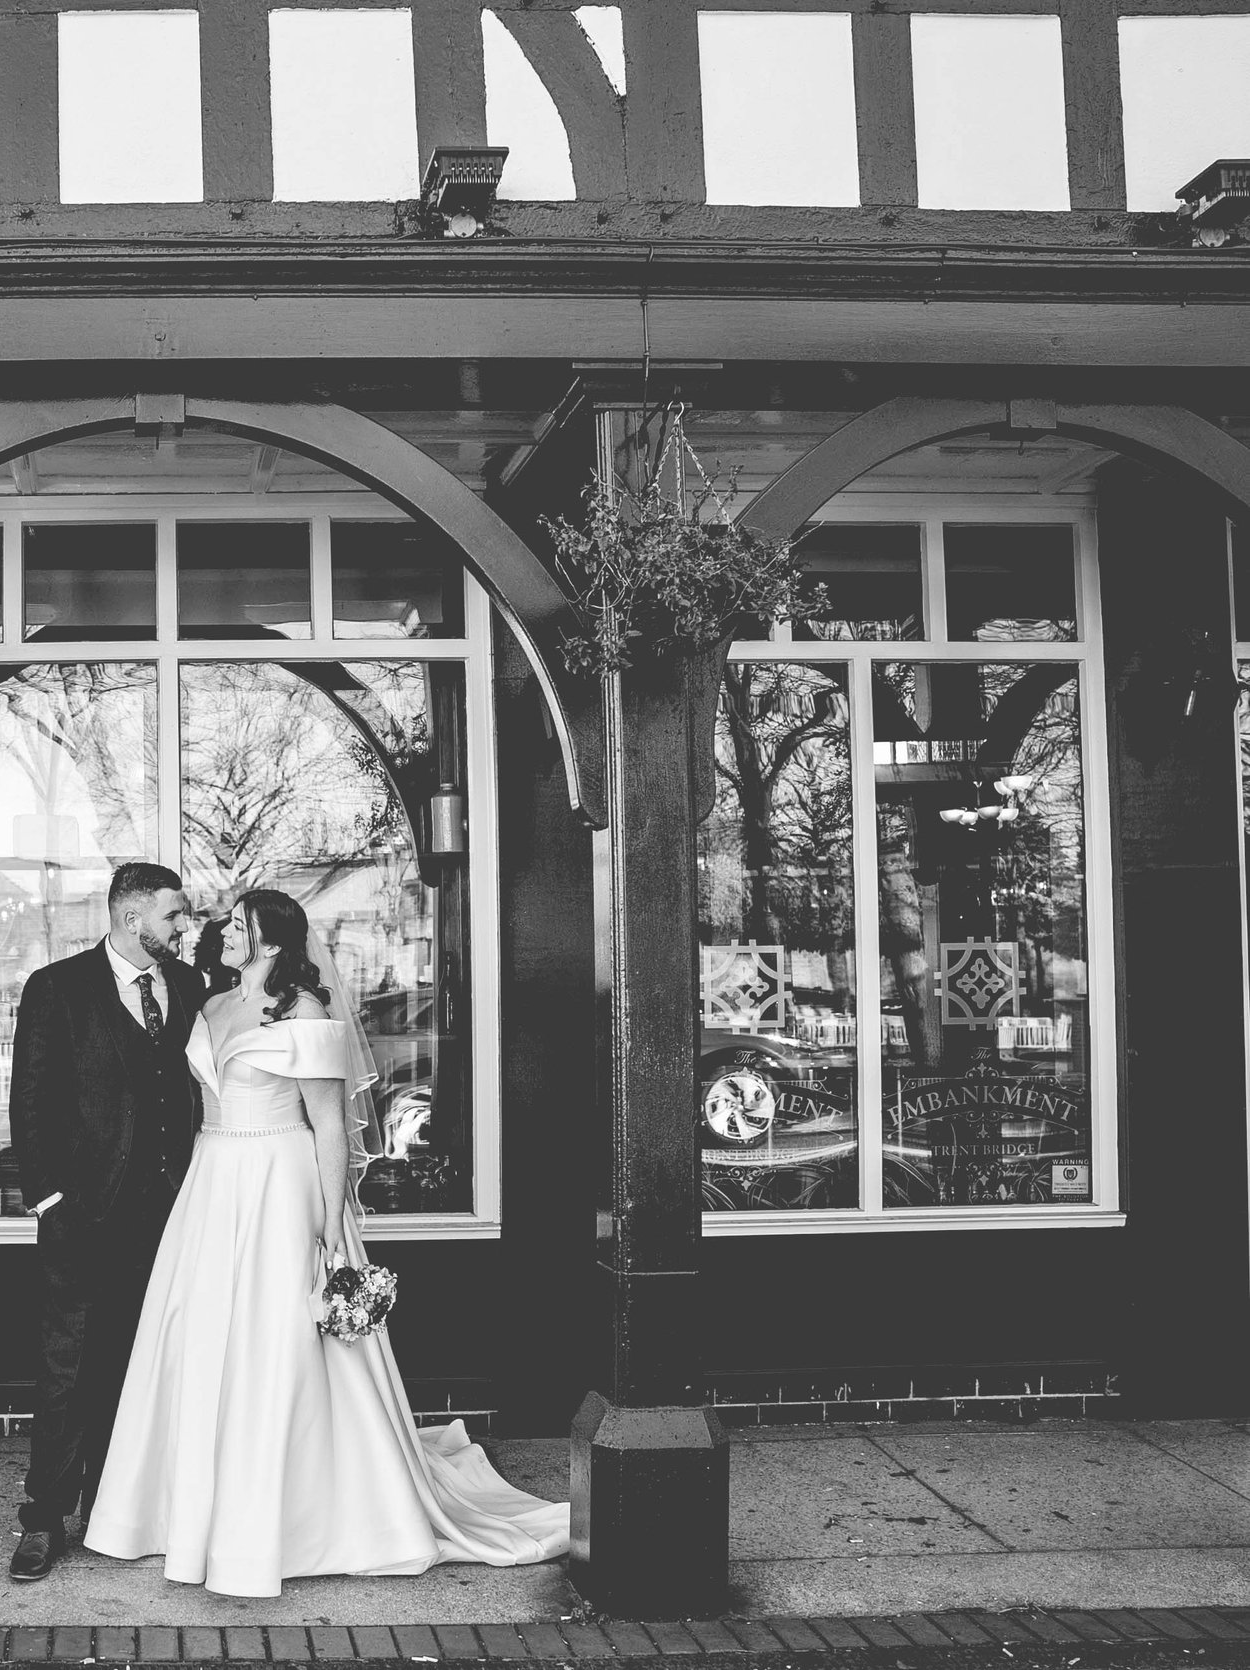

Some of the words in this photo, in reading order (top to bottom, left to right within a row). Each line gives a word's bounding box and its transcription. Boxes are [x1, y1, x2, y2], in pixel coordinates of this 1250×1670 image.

[734, 1049, 756, 1065] The
[970, 1046, 992, 1060] The
[887, 1085, 1079, 1127] EMBANKMENT
[931, 1144, 982, 1157] TRENT
[983, 1143, 1037, 1157] BRIDGE
